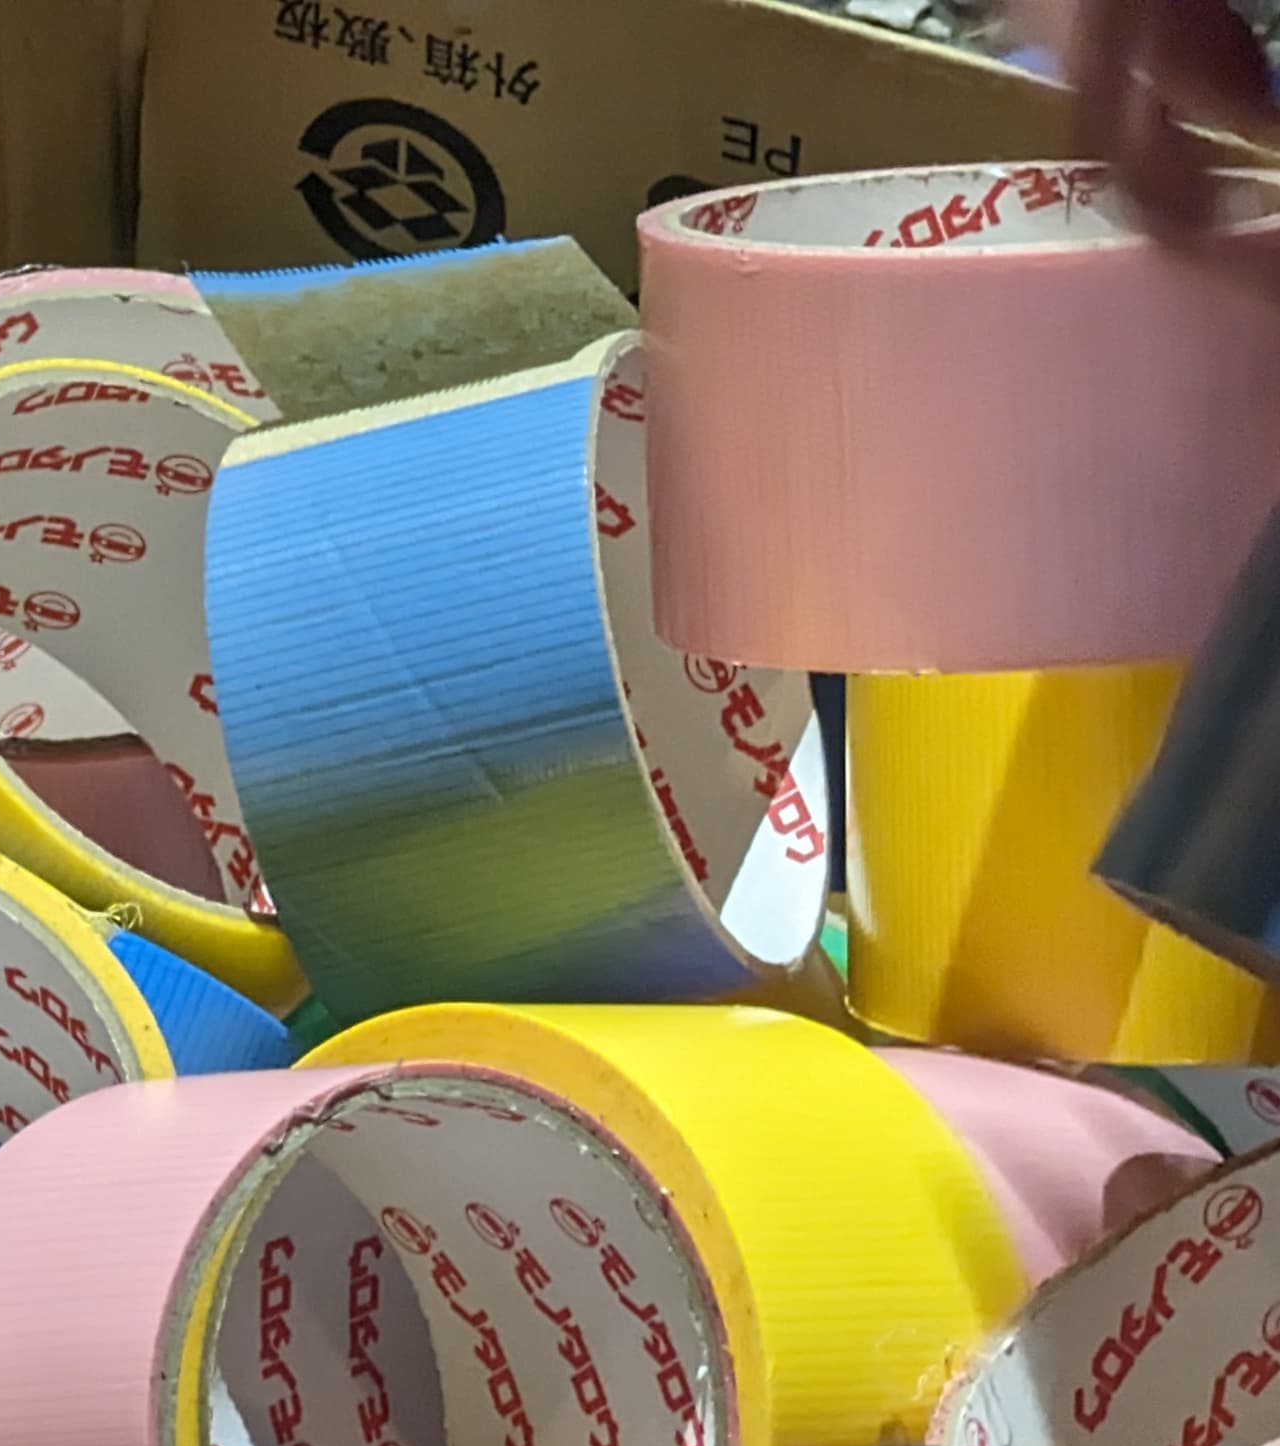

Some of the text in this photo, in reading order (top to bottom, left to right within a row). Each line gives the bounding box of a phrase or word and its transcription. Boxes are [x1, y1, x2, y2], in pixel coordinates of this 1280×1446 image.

[721, 113, 801, 176] PE
[863, 168, 1062, 248] モノタロ
[721, 682, 825, 864] モノタロウ
[258, 1235, 302, 1446] モノタロウ
[347, 1234, 390, 1444] モノタロウ
[1073, 1237, 1223, 1434] モノタロウ
